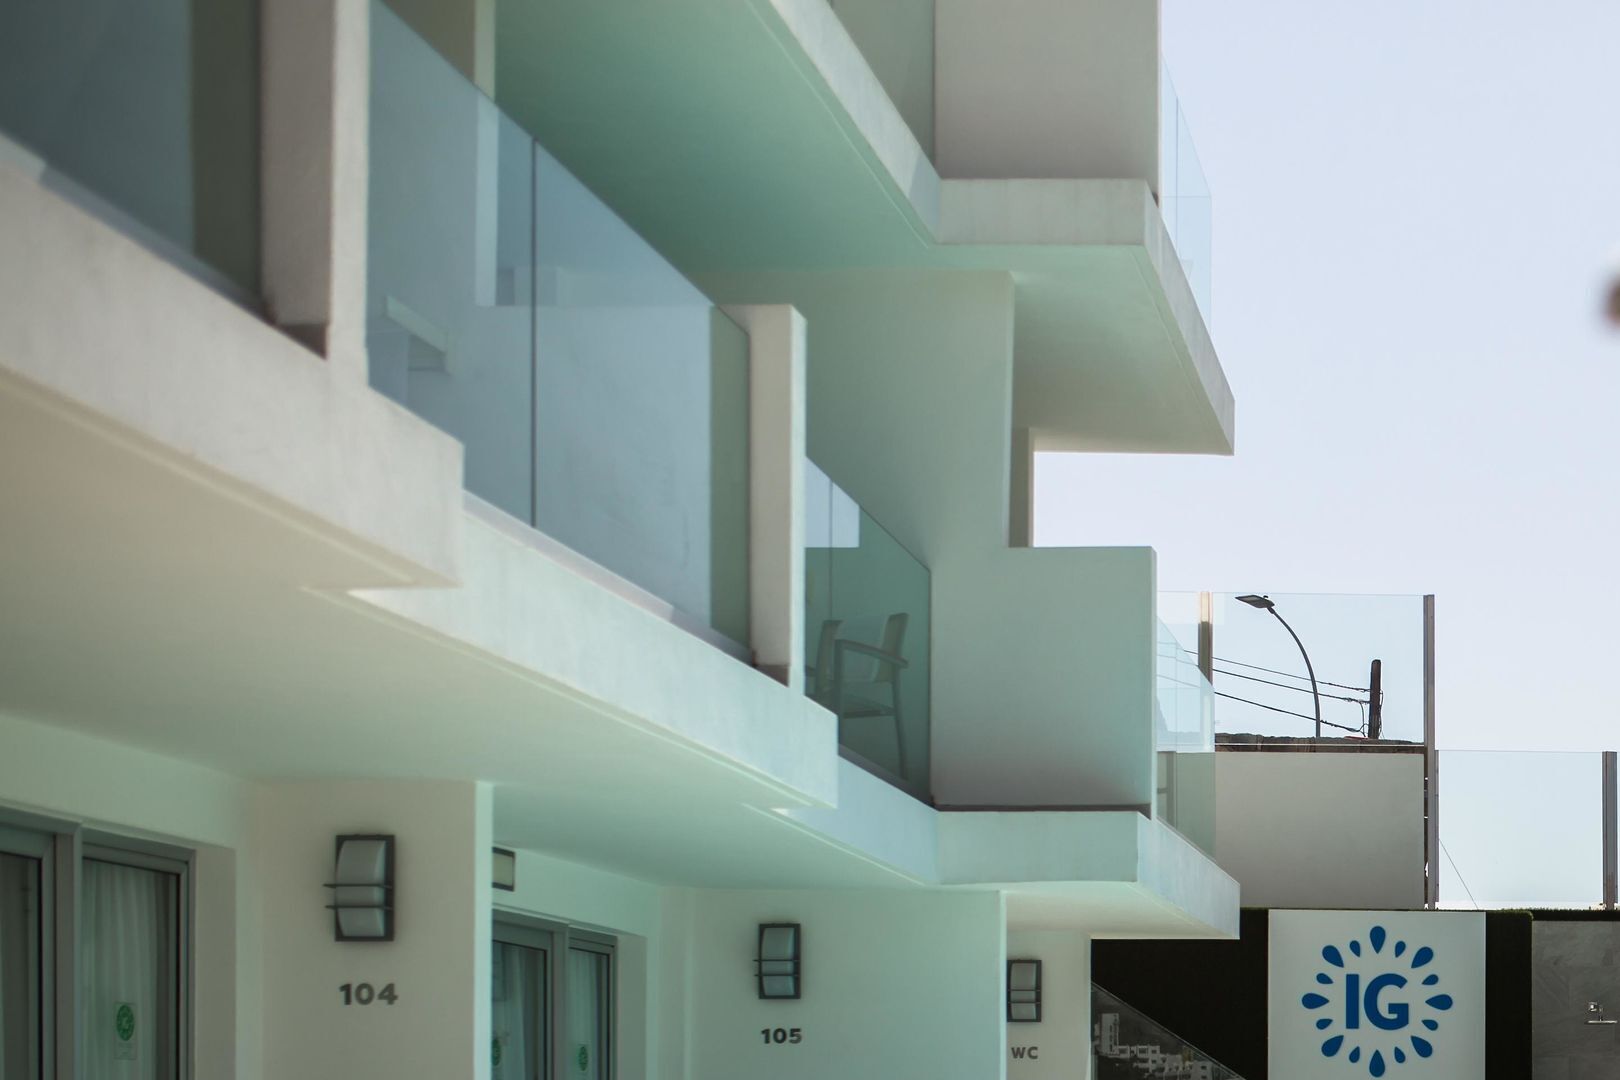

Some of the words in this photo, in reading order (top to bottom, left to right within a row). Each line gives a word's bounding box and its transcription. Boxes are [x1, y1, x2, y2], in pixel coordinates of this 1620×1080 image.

[339, 982, 398, 1006] 104
[1345, 973, 1410, 1031] IG
[761, 1027, 802, 1045] 105
[1010, 1046, 1039, 1060] WC
